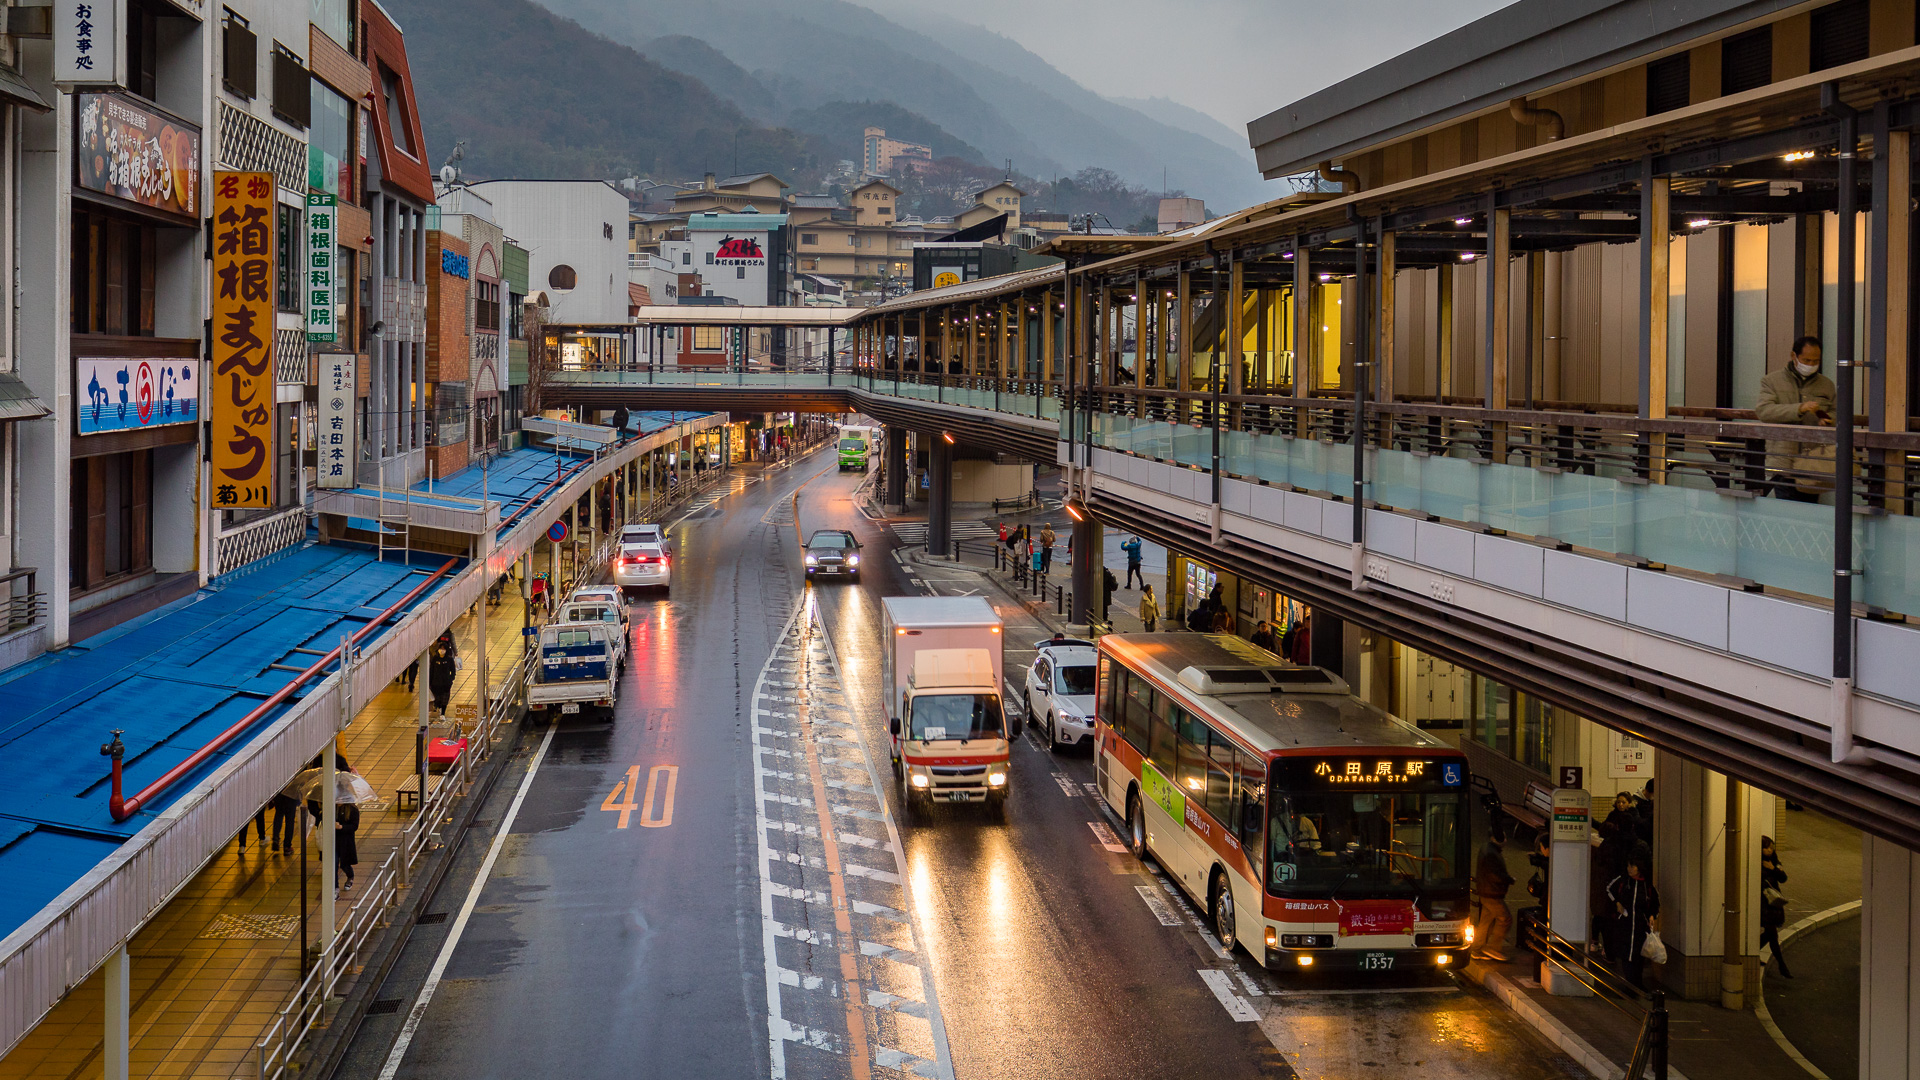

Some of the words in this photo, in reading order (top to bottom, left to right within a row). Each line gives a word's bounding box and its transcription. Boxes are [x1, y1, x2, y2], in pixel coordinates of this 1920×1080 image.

[75, 3, 94, 70] お食事処
[217, 175, 270, 199] 名物
[310, 196, 331, 204] 3F
[311, 213, 330, 325] 箱根歯科医院
[217, 204, 270, 481] 箱根まんじゅう
[344, 360, 352, 389] 土産処
[330, 415, 345, 476] 吉田本店
[216, 484, 268, 505] 菊川
[1315, 762, 1424, 775] 小田原駅
[1566, 768, 1576, 784] 5
[600, 765, 680, 829] 40
[1285, 902, 1329, 910] 箱根登山バス
[1366, 957, 1394, 969] 13-57
